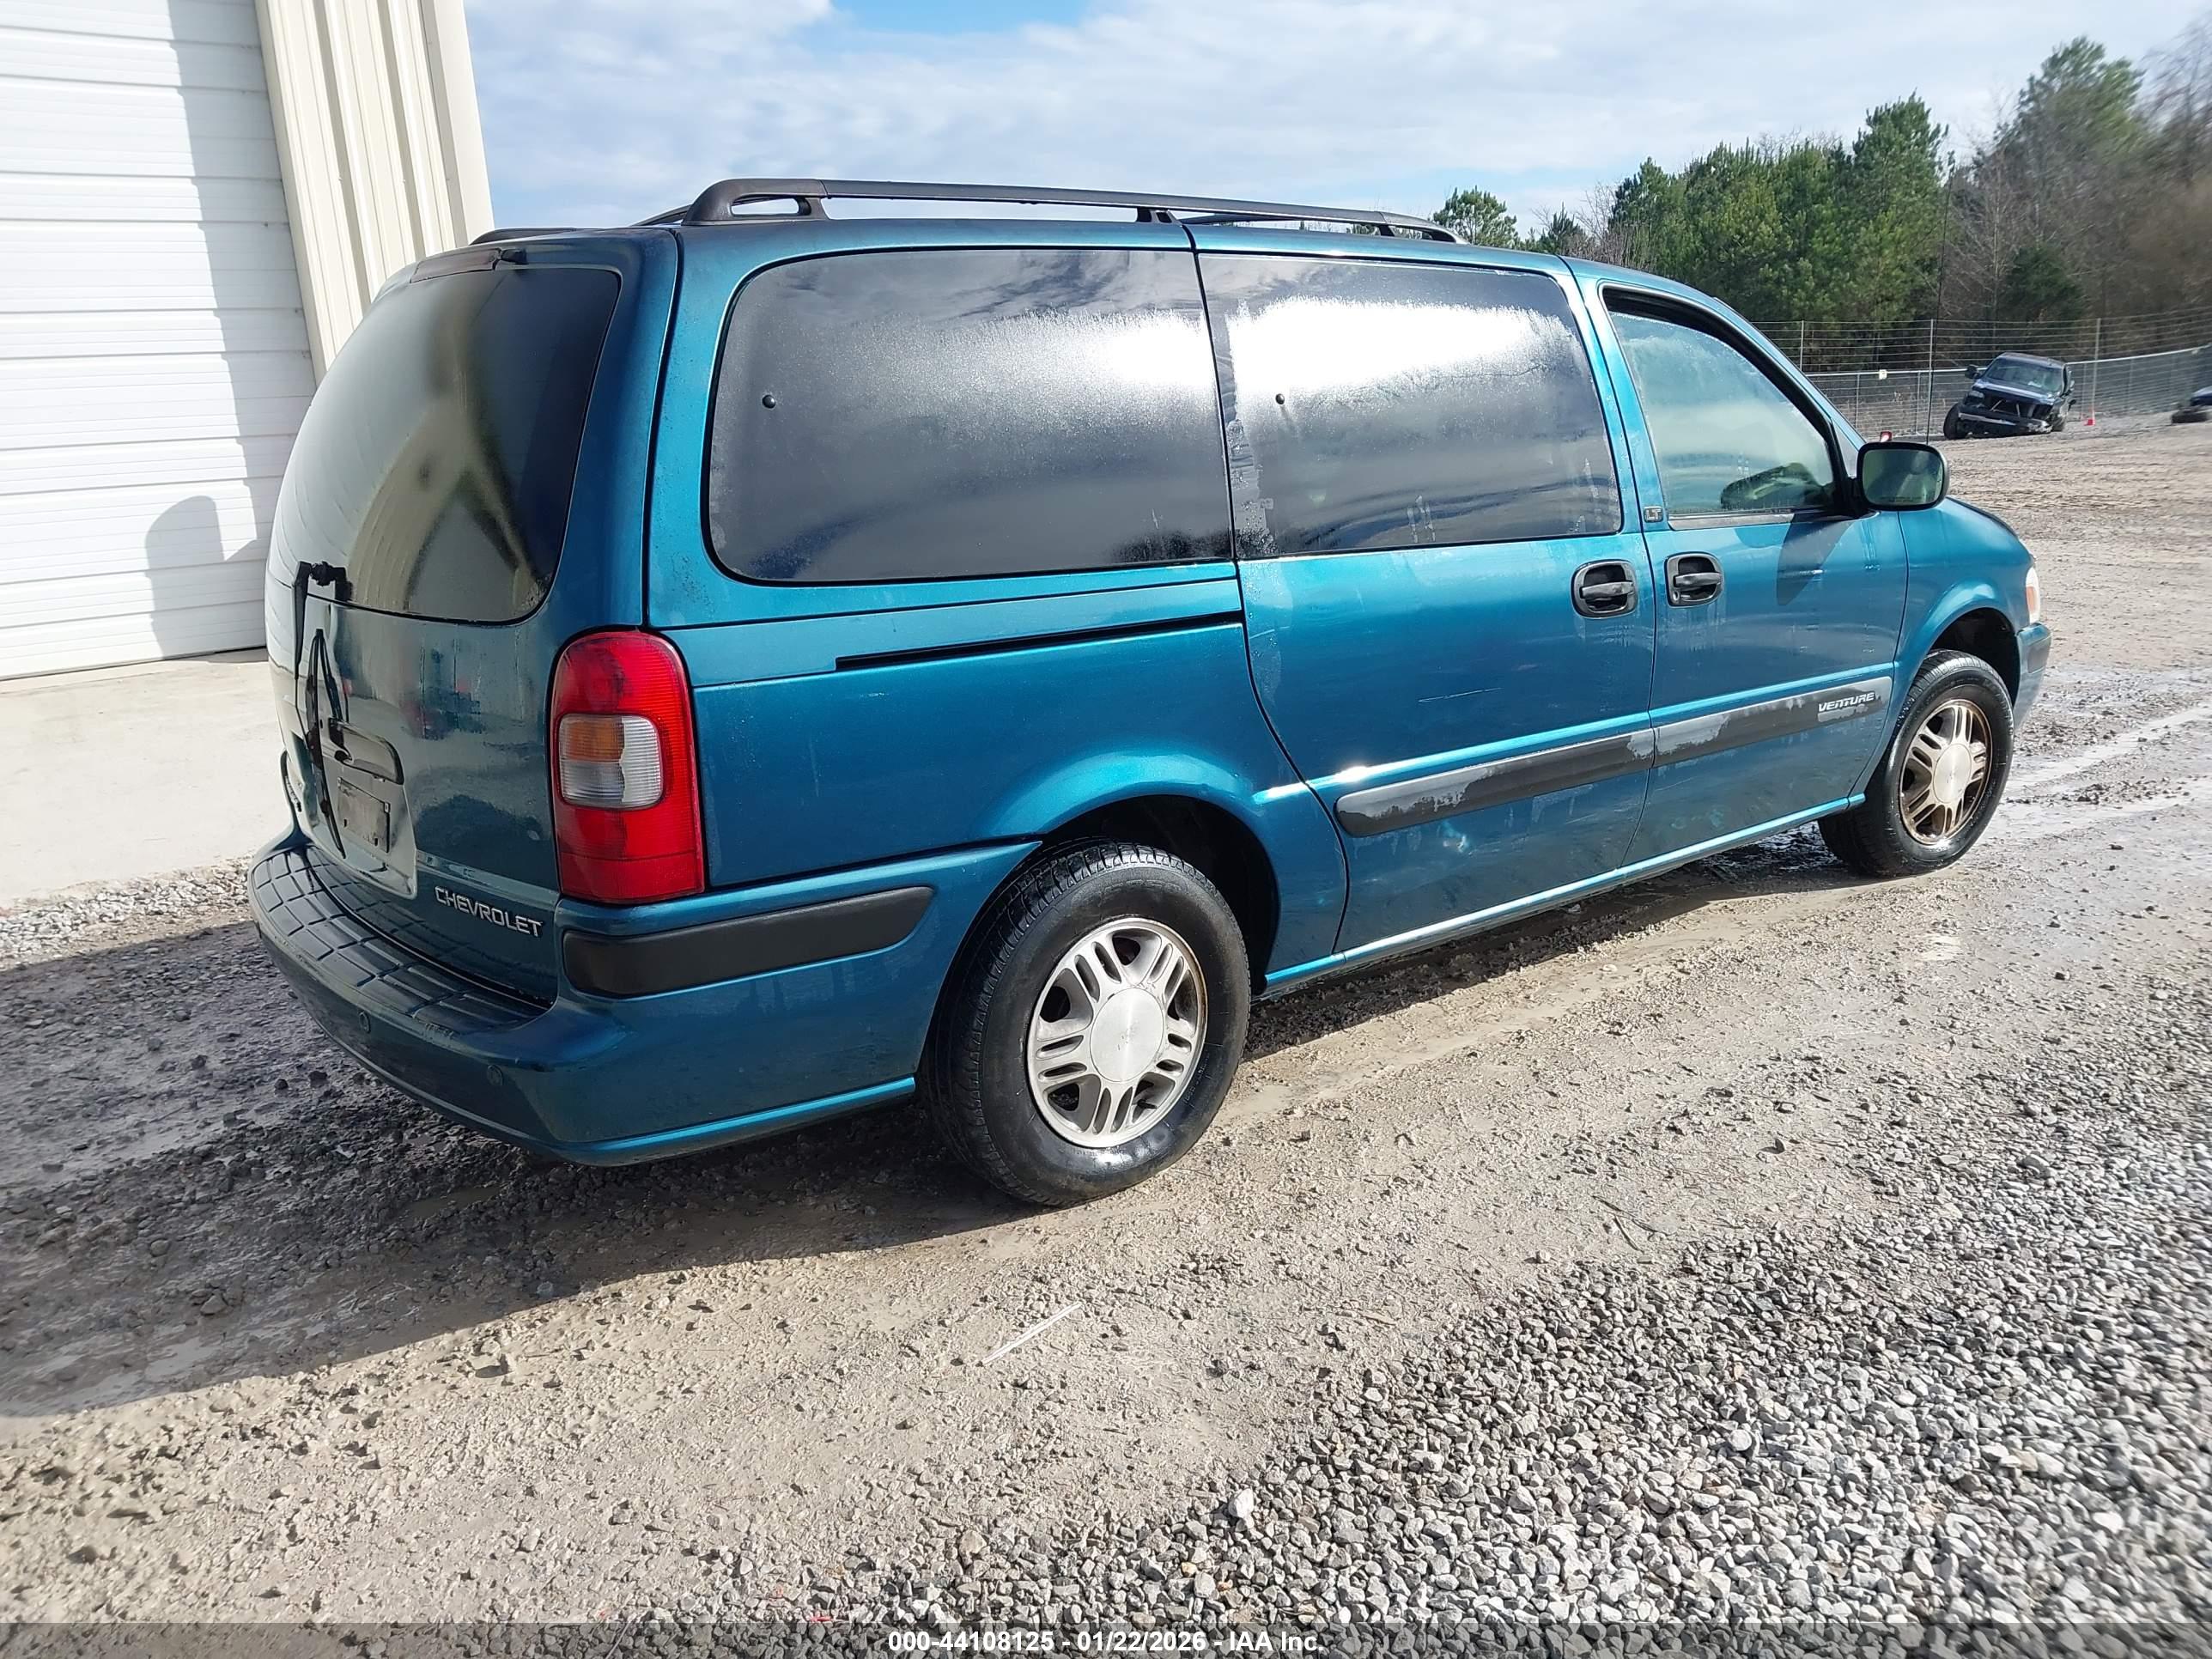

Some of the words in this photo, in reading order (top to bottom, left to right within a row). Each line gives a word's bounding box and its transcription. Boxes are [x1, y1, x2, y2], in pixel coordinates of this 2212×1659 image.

[1645, 508, 1662, 520] LT
[1818, 691, 1875, 712] VENTURE
[434, 885, 543, 937] CHEVROLET
